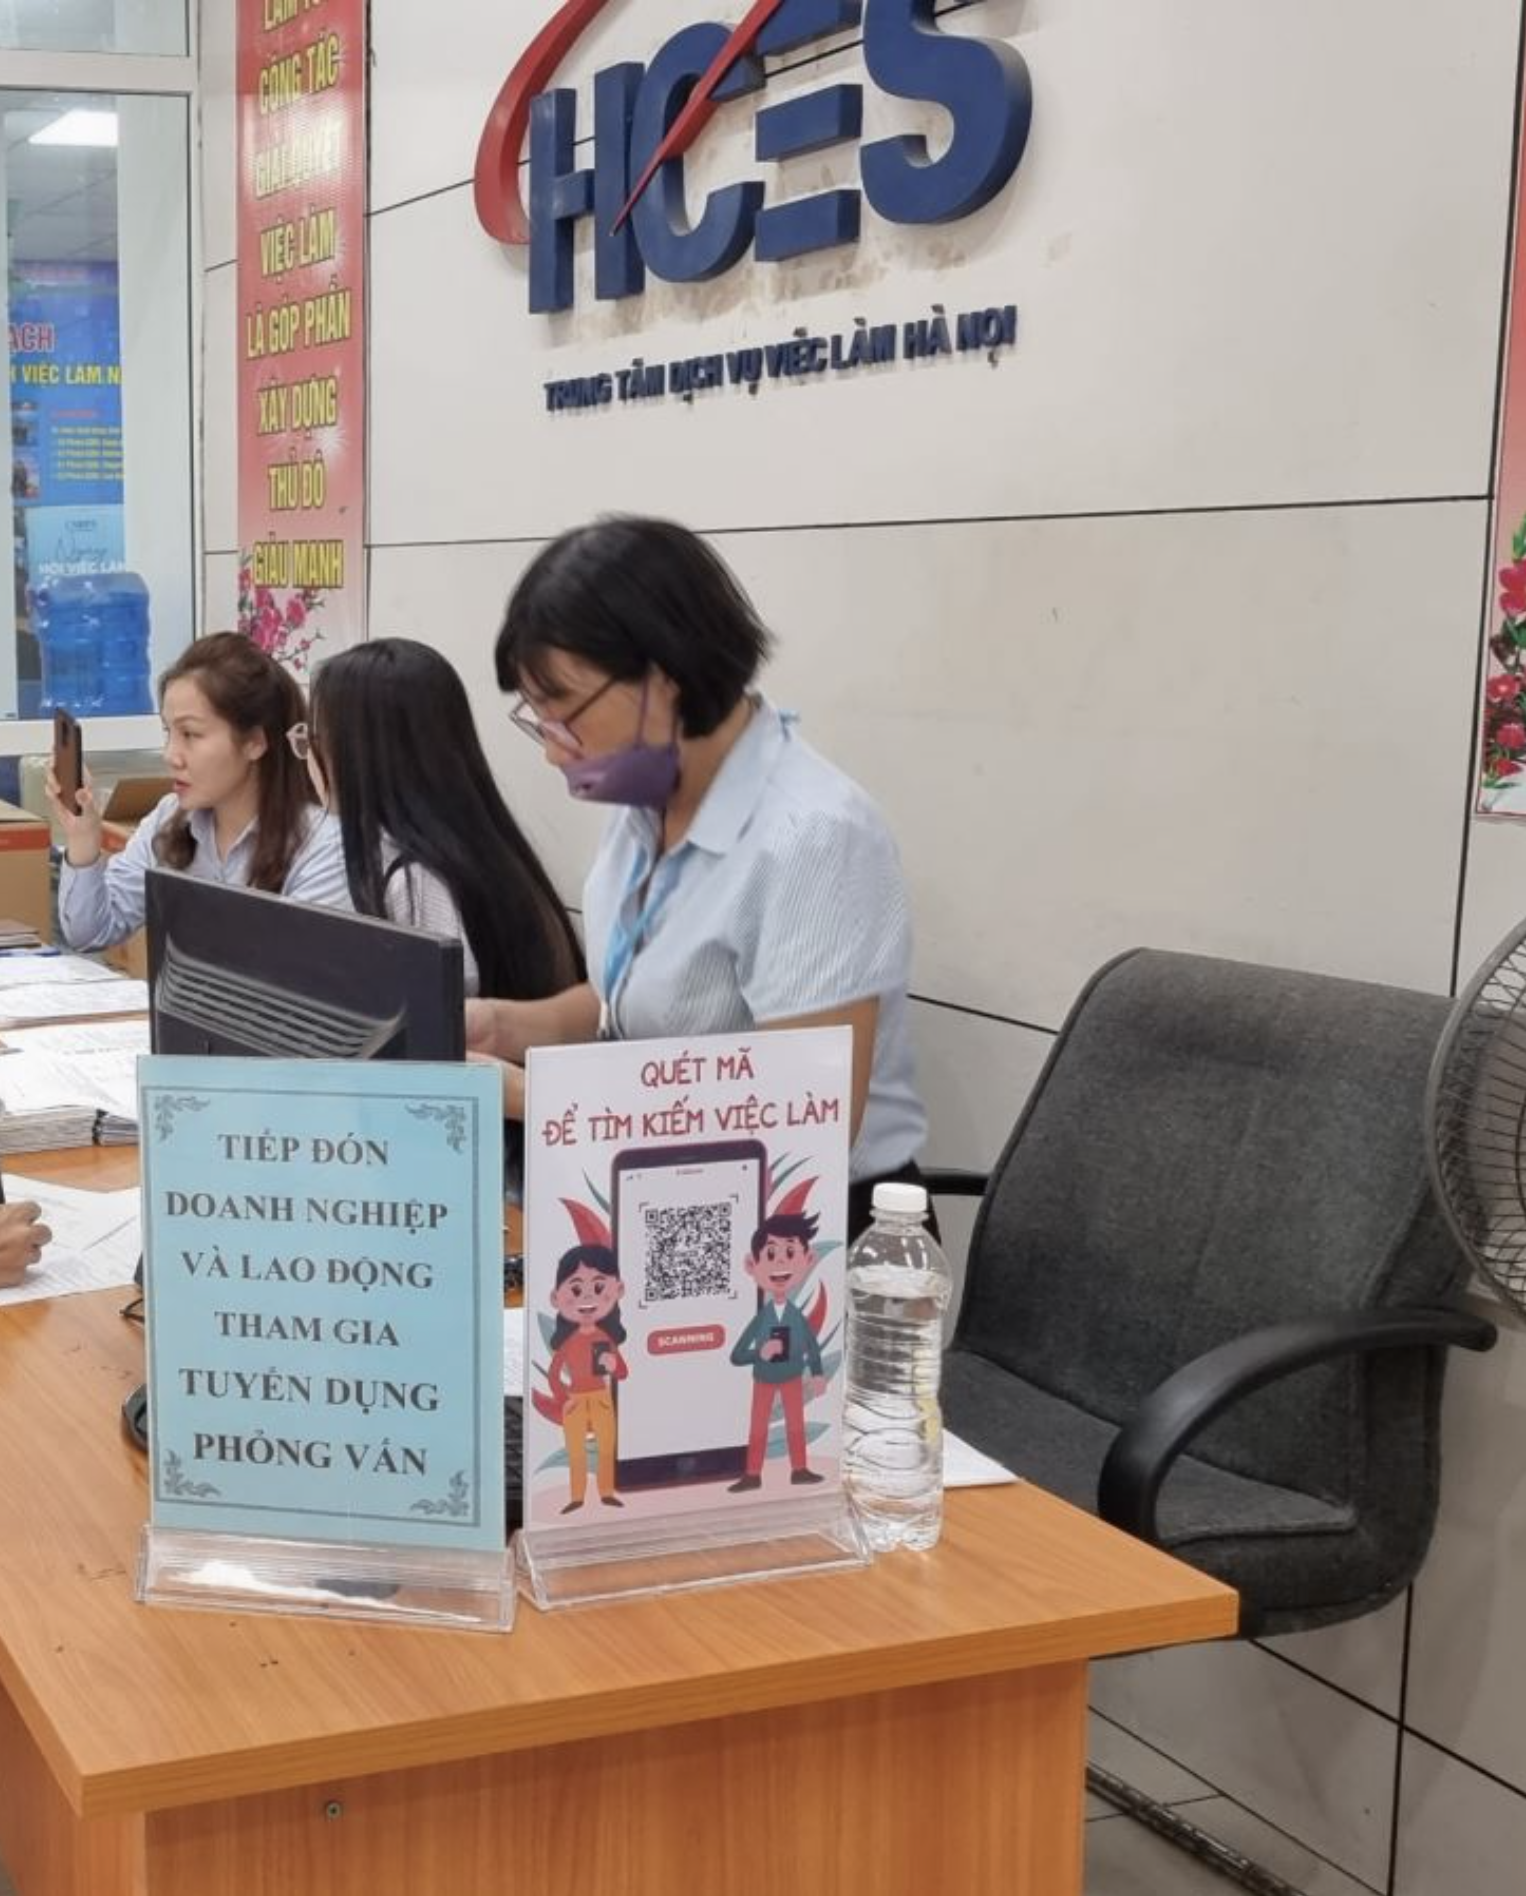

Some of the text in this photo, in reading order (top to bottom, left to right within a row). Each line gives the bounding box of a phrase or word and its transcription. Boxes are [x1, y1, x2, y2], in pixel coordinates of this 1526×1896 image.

[261, 202, 335, 285] VIỆC LÀM
[246, 301, 265, 360] LÀ
[269, 293, 300, 356] GÓP
[544, 371, 613, 411] TRUNG
[614, 356, 666, 401] TÂM
[669, 353, 724, 405] DỊCH
[725, 346, 764, 395] VỤ
[830, 315, 898, 371] LÀM
[902, 303, 954, 360] HÀ
[640, 1046, 754, 1088] QUÉT MÃ
[541, 1091, 840, 1146] ĐỂ TÌM KIẾM VIỆC LÀM
[217, 1128, 389, 1166] TIẾP ĐÓN
[165, 1190, 449, 1236] DOANH NGHIỆP
[181, 1244, 434, 1293] VÀ LAO ĐỘNG
[214, 1311, 400, 1348] THAM GIA
[178, 1366, 440, 1415] TUYỂN DỤNG
[193, 1429, 428, 1477] PHỎNG VẤN
